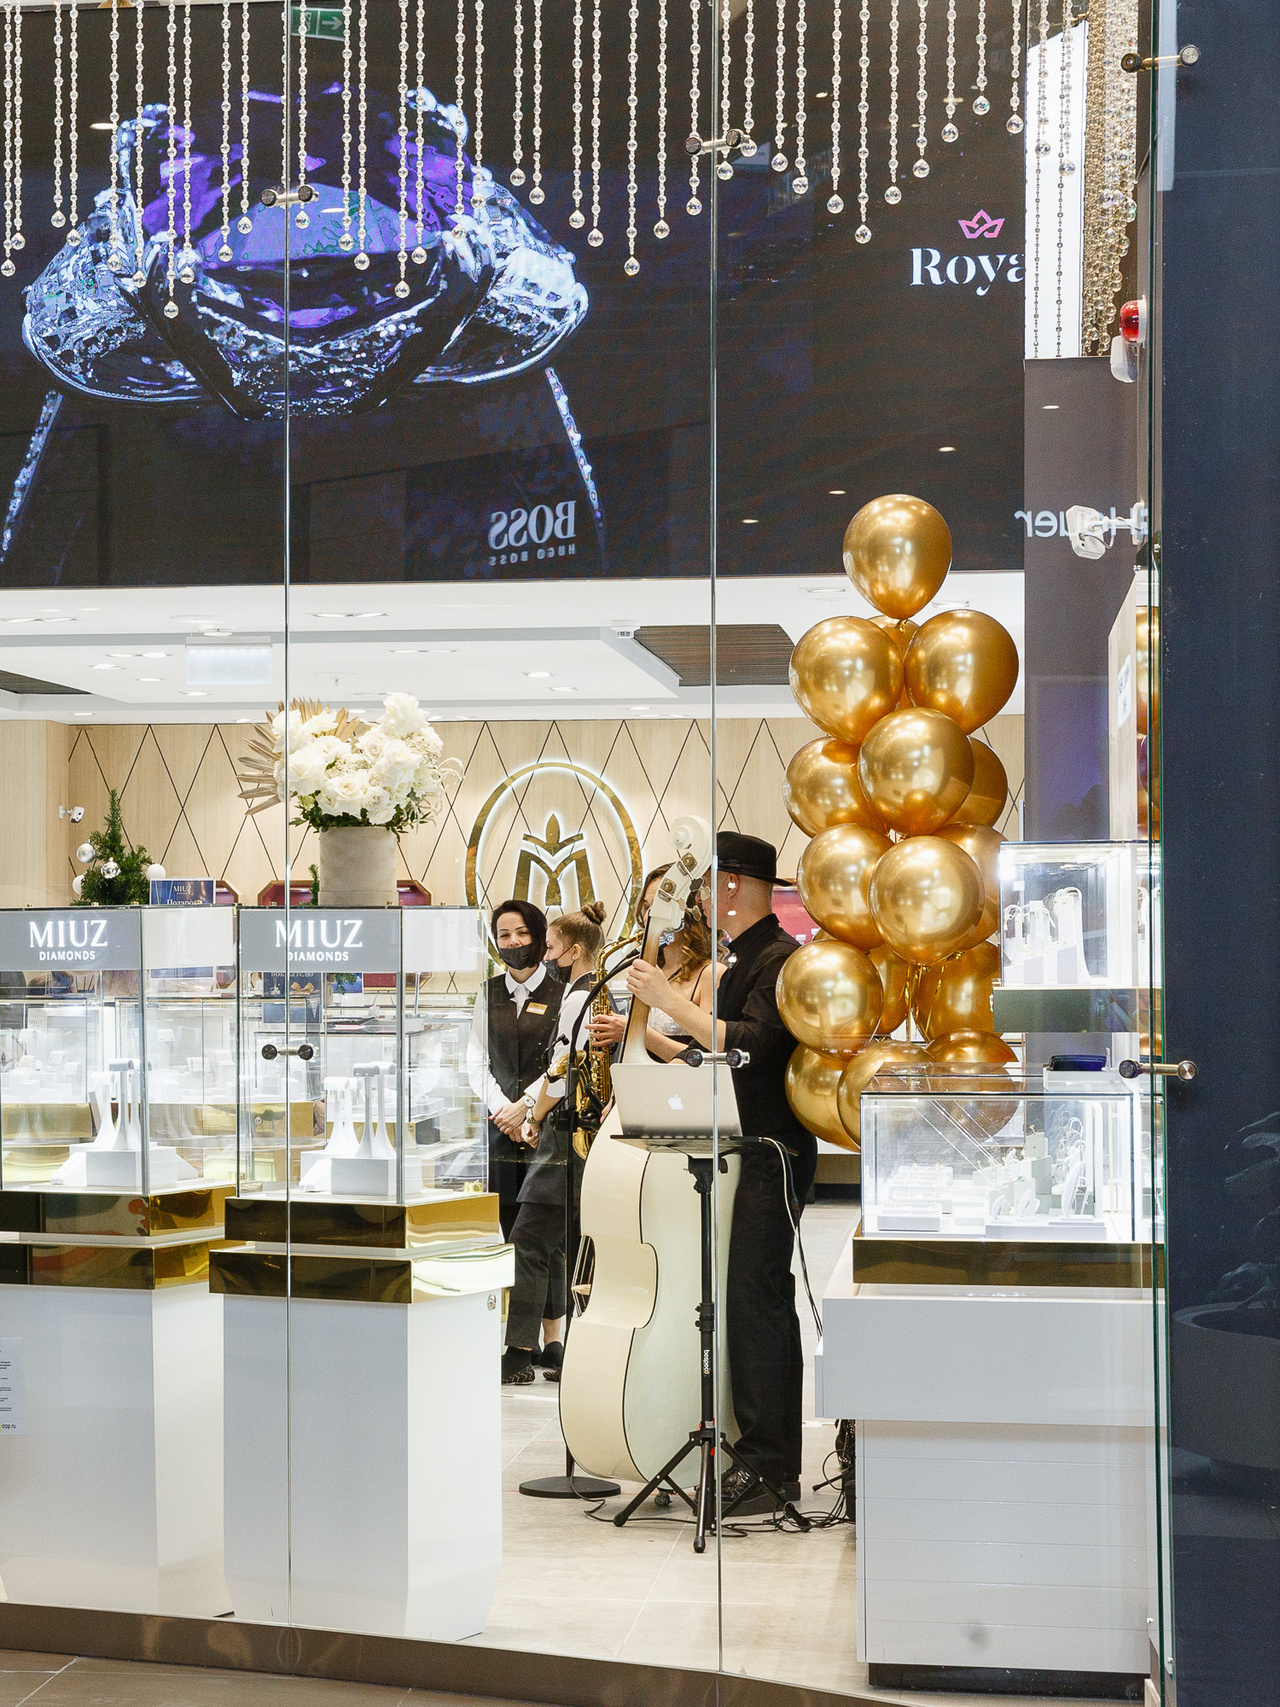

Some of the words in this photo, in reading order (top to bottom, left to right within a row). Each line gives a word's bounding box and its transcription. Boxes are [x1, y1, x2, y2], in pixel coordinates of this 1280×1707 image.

[173, 885, 192, 893] MIUZ
[29, 919, 108, 948] MIUZ
[275, 919, 363, 948] MIUZ
[39, 950, 96, 961] DIAMONDS
[287, 951, 349, 962] DIAMONDS
